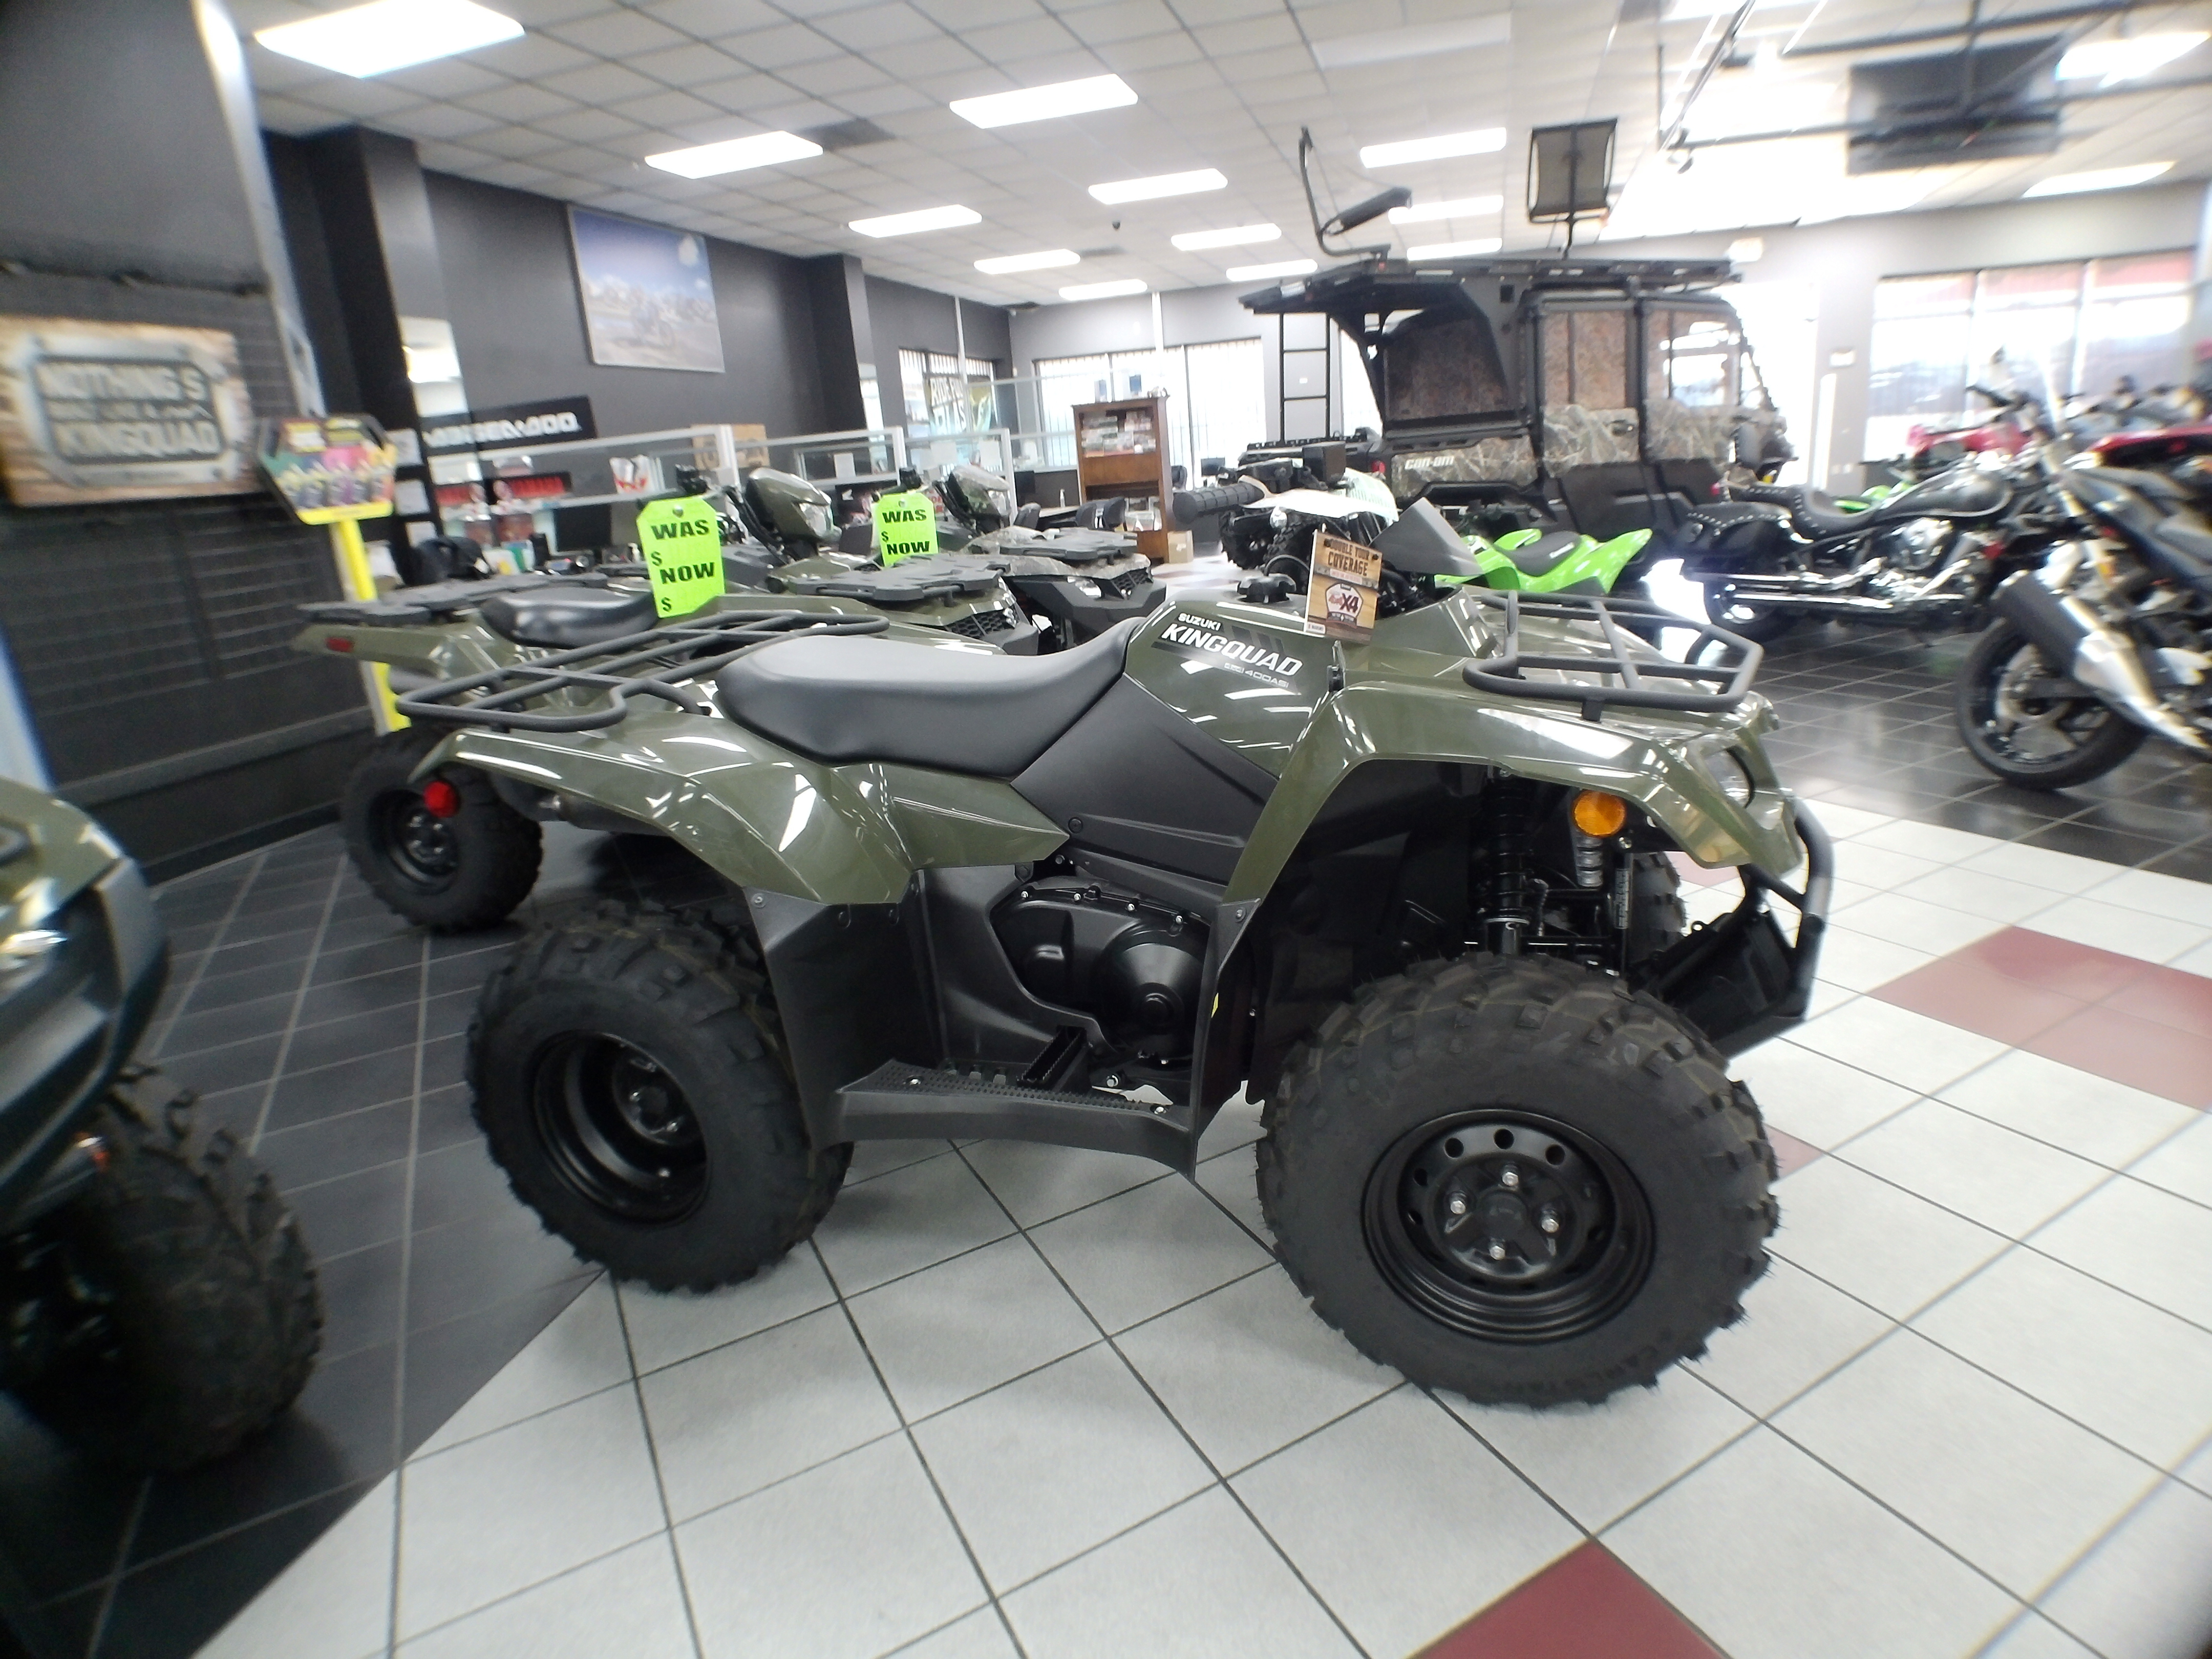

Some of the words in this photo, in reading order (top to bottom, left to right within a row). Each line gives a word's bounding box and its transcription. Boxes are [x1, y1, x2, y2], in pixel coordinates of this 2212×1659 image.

[882, 509, 927, 524] WAS
[651, 519, 709, 540] WAS
[886, 541, 930, 556] NOW
[660, 562, 715, 584] NOW
[1328, 551, 1369, 576] COVERAGE
[1178, 613, 1222, 631] SUZUKI
[1161, 624, 1303, 676] KINGQUAD
